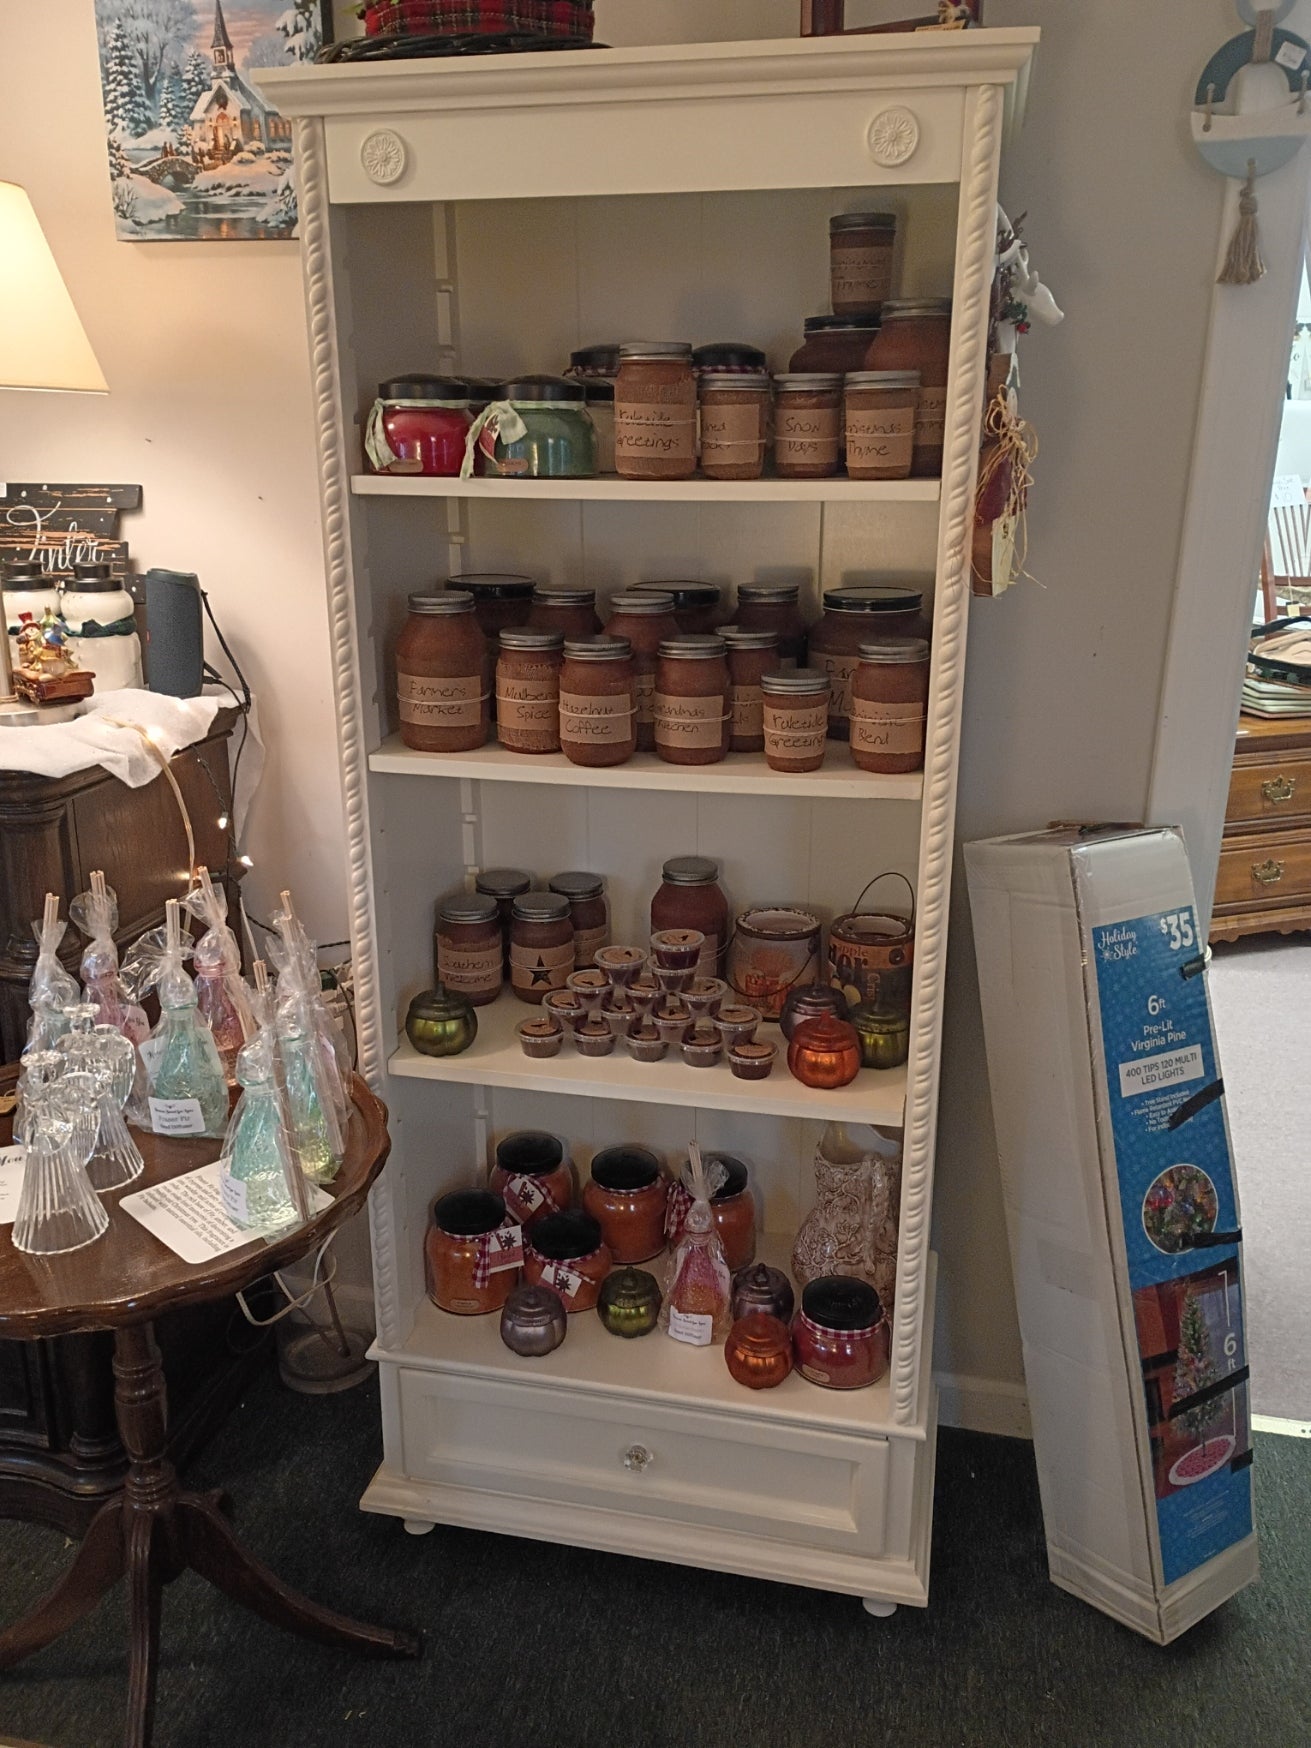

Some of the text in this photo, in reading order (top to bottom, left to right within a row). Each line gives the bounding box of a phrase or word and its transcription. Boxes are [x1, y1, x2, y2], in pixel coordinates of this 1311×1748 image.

[409, 680, 467, 698] Farmers
[516, 704, 553, 722] Spice
[565, 719, 612, 735] Coffee
[859, 727, 889, 745] Blend
[1097, 926, 1137, 950] Holiday
[1160, 911, 1194, 950] $35
[1113, 942, 1137, 960] Style
[1143, 1019, 1174, 1036] Pre-Lit
[1131, 1031, 1187, 1052] Virginia Pine
[1125, 1052, 1198, 1078] 400 TIPS 120 MULTI
[1141, 1066, 1185, 1086] LED LIGHTS
[1224, 1332, 1237, 1356] 6
